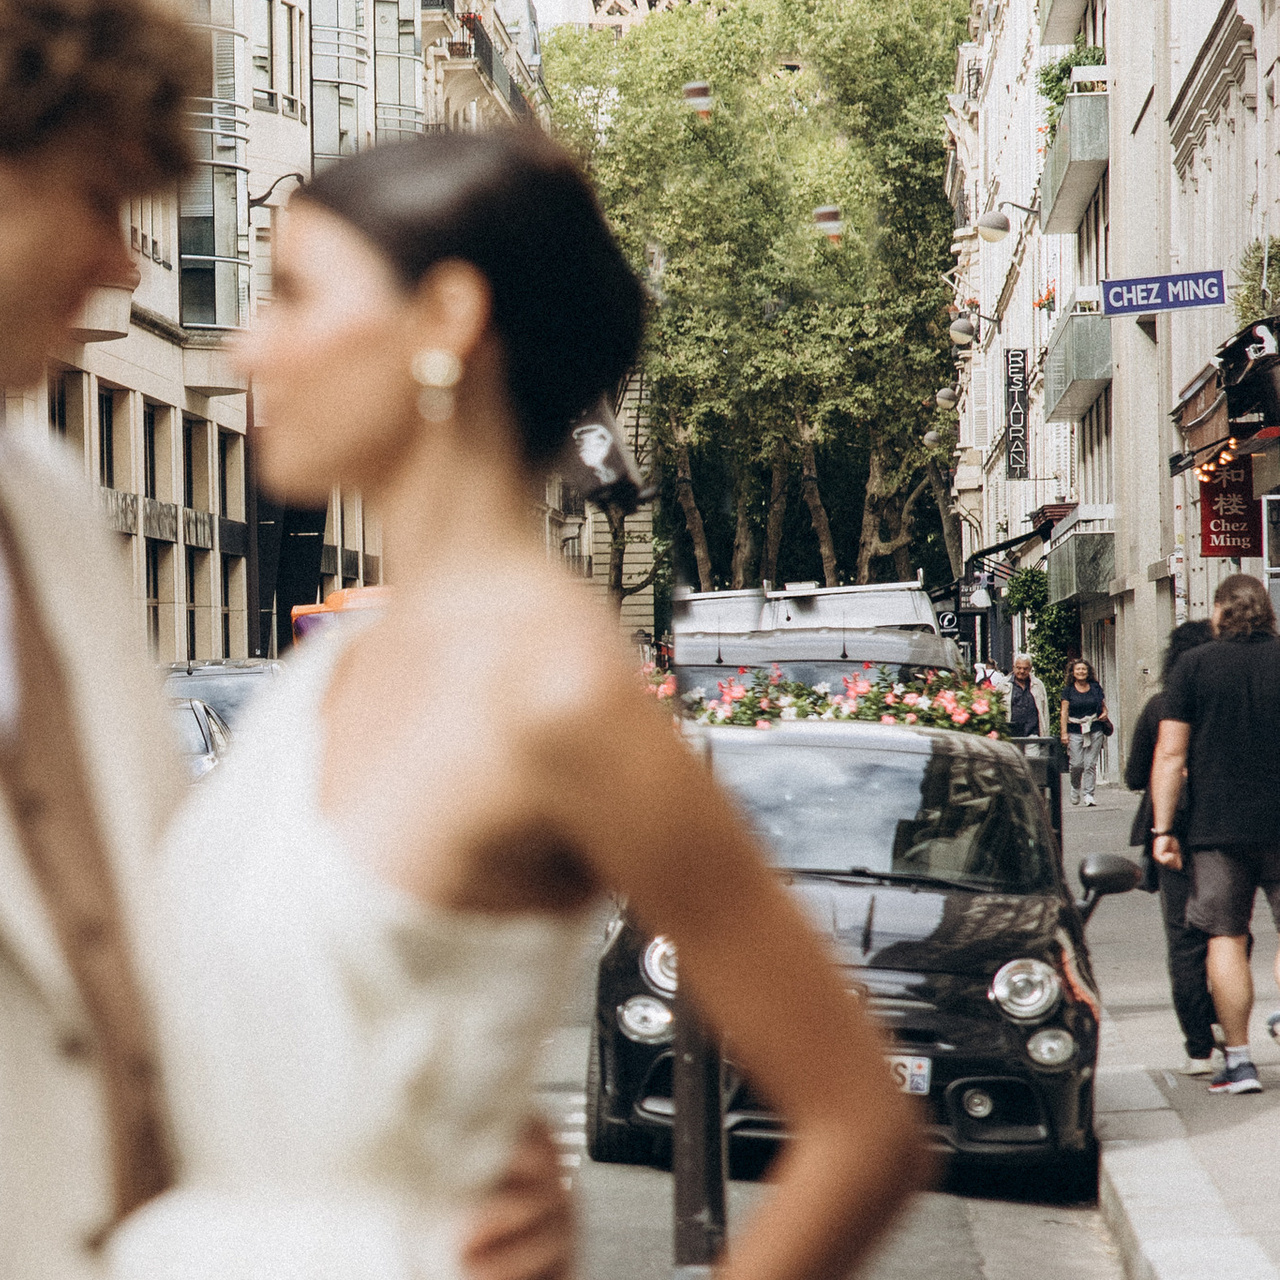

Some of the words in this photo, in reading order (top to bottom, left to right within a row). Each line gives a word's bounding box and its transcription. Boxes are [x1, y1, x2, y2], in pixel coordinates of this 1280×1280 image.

[1108, 282, 1162, 308] CHEZ
[1167, 277, 1219, 303] MING
[1008, 349, 1026, 477] RESTAURANT
[1209, 519, 1249, 532] Chez
[1209, 533, 1252, 549] Ming
